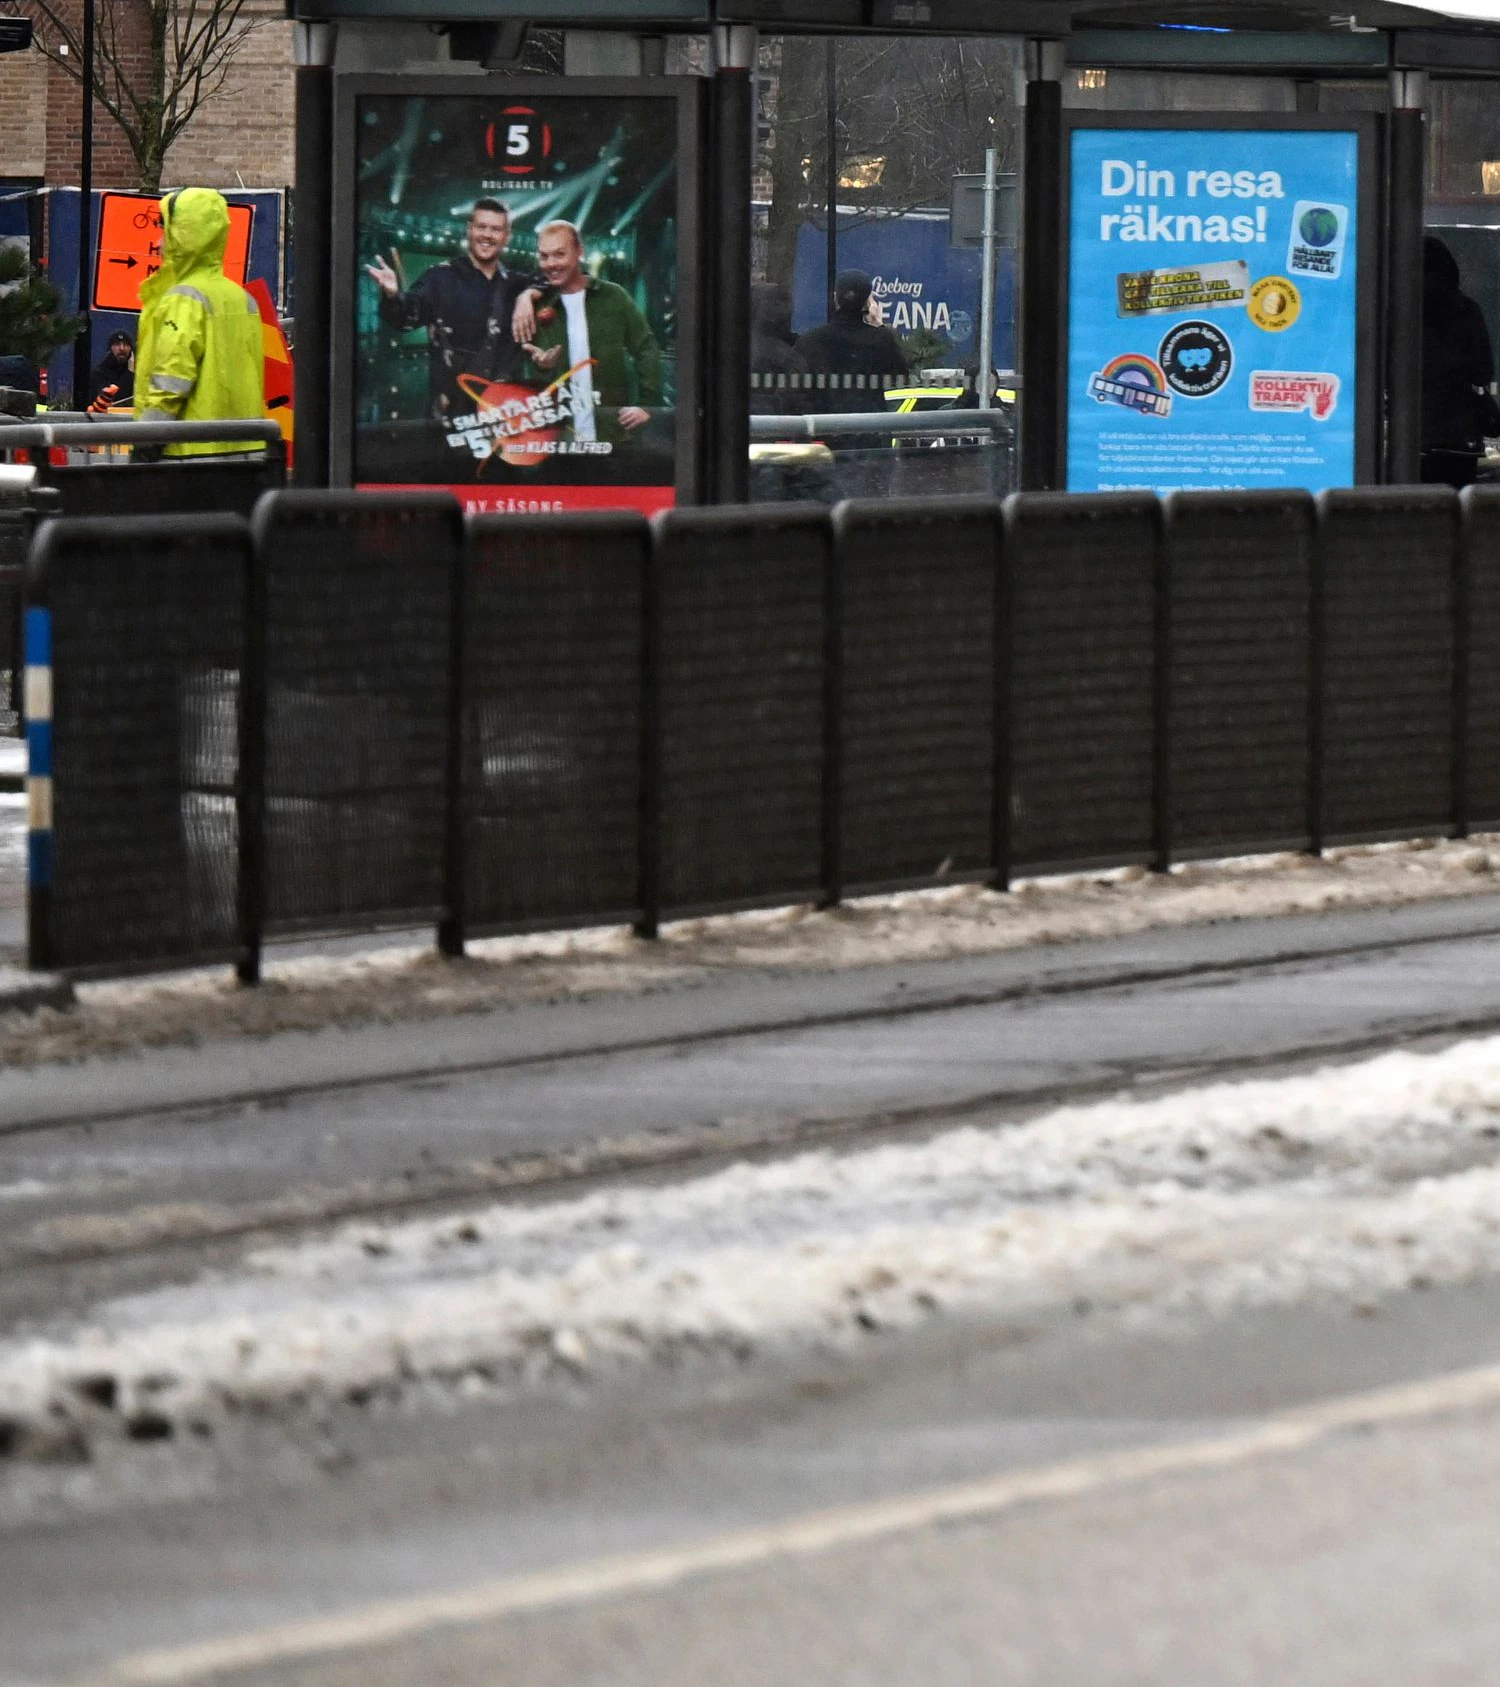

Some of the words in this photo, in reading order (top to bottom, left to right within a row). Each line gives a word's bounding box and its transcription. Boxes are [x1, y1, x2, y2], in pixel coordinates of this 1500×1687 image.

[506, 124, 530, 156] 5
[1101, 159, 1176, 198] Din
[1187, 169, 1285, 199] resa
[1100, 204, 1268, 243] räknas!
[871, 275, 923, 298] Liseberg
[877, 301, 951, 331] EANA
[1253, 391, 1306, 402] TRAFIK
